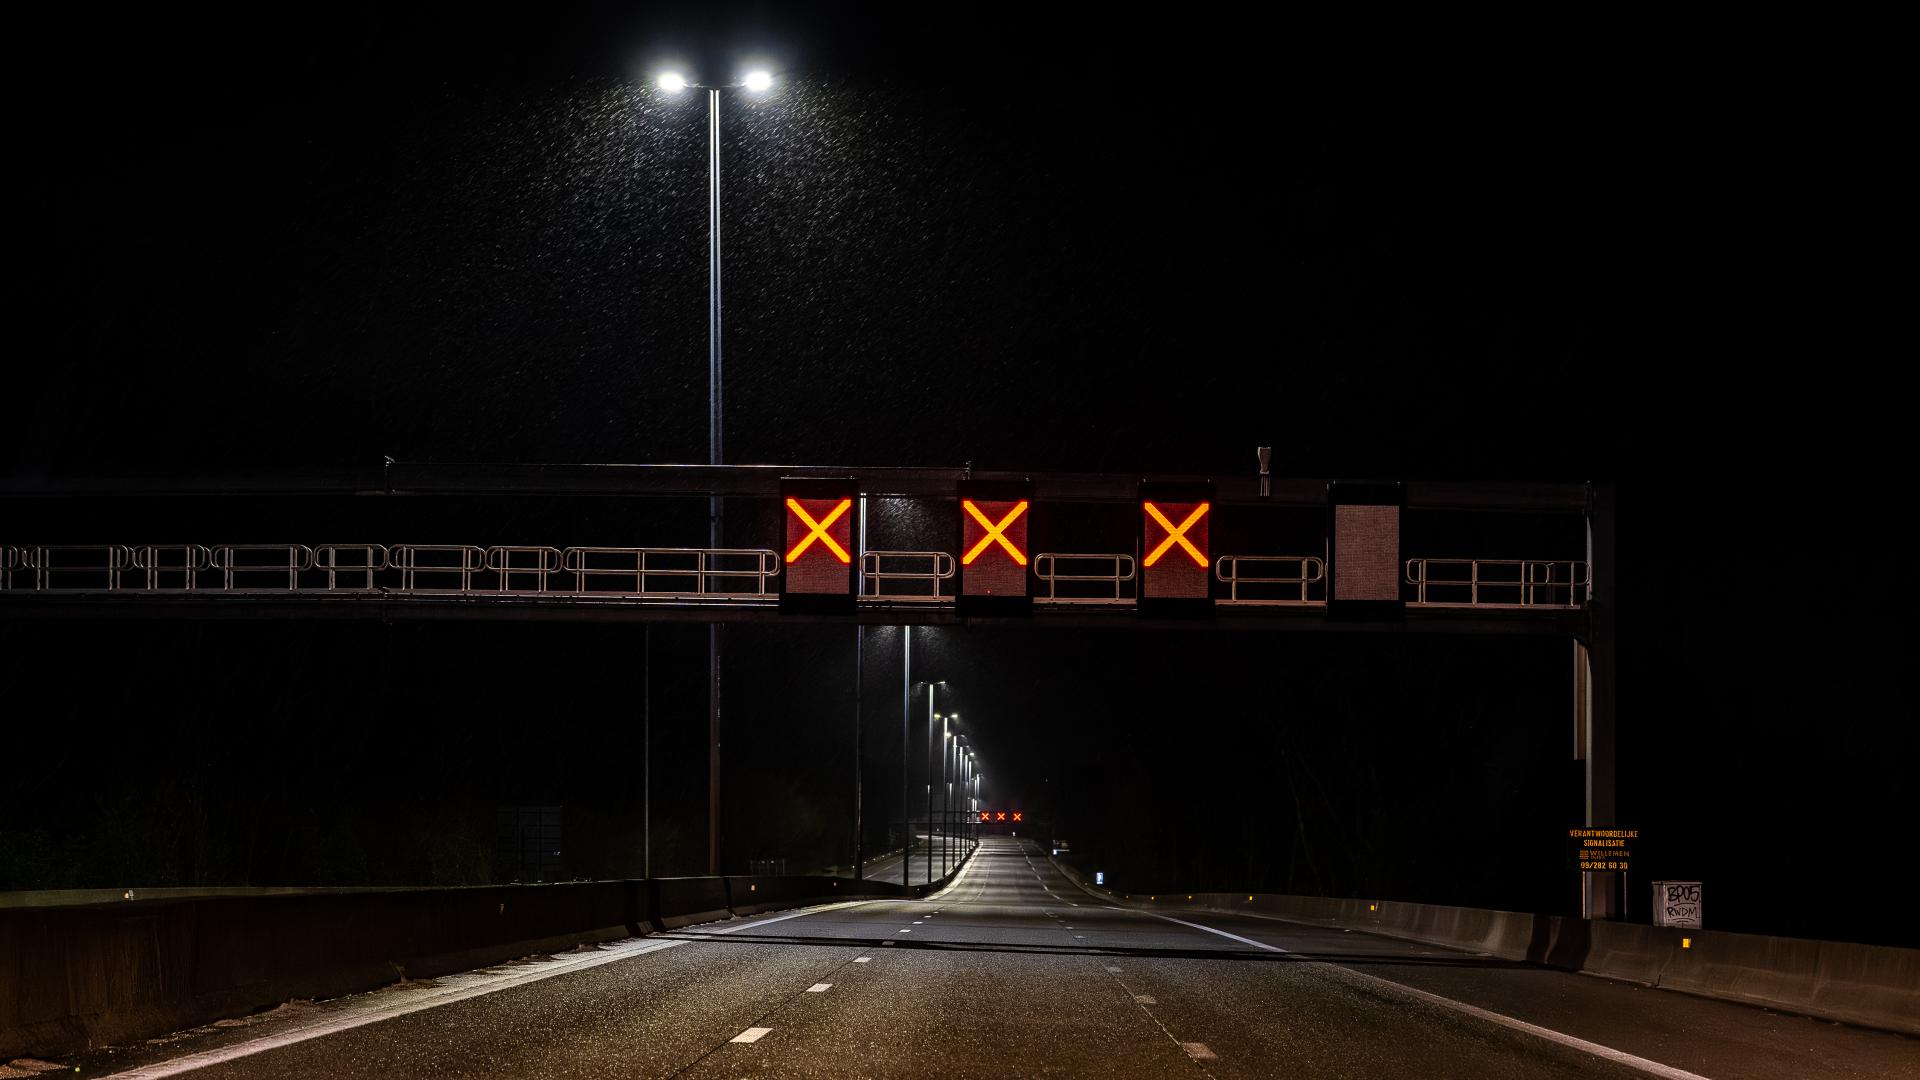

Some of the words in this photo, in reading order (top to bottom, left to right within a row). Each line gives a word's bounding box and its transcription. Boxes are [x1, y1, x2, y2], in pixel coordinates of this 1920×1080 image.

[1569, 829, 1639, 838] VERANTWOORDELIJKE
[1583, 839, 1625, 847] SIGNALISATIE
[1581, 861, 1606, 869] 09/282
[1608, 861, 1617, 869] 60
[1619, 861, 1628, 869] 30
